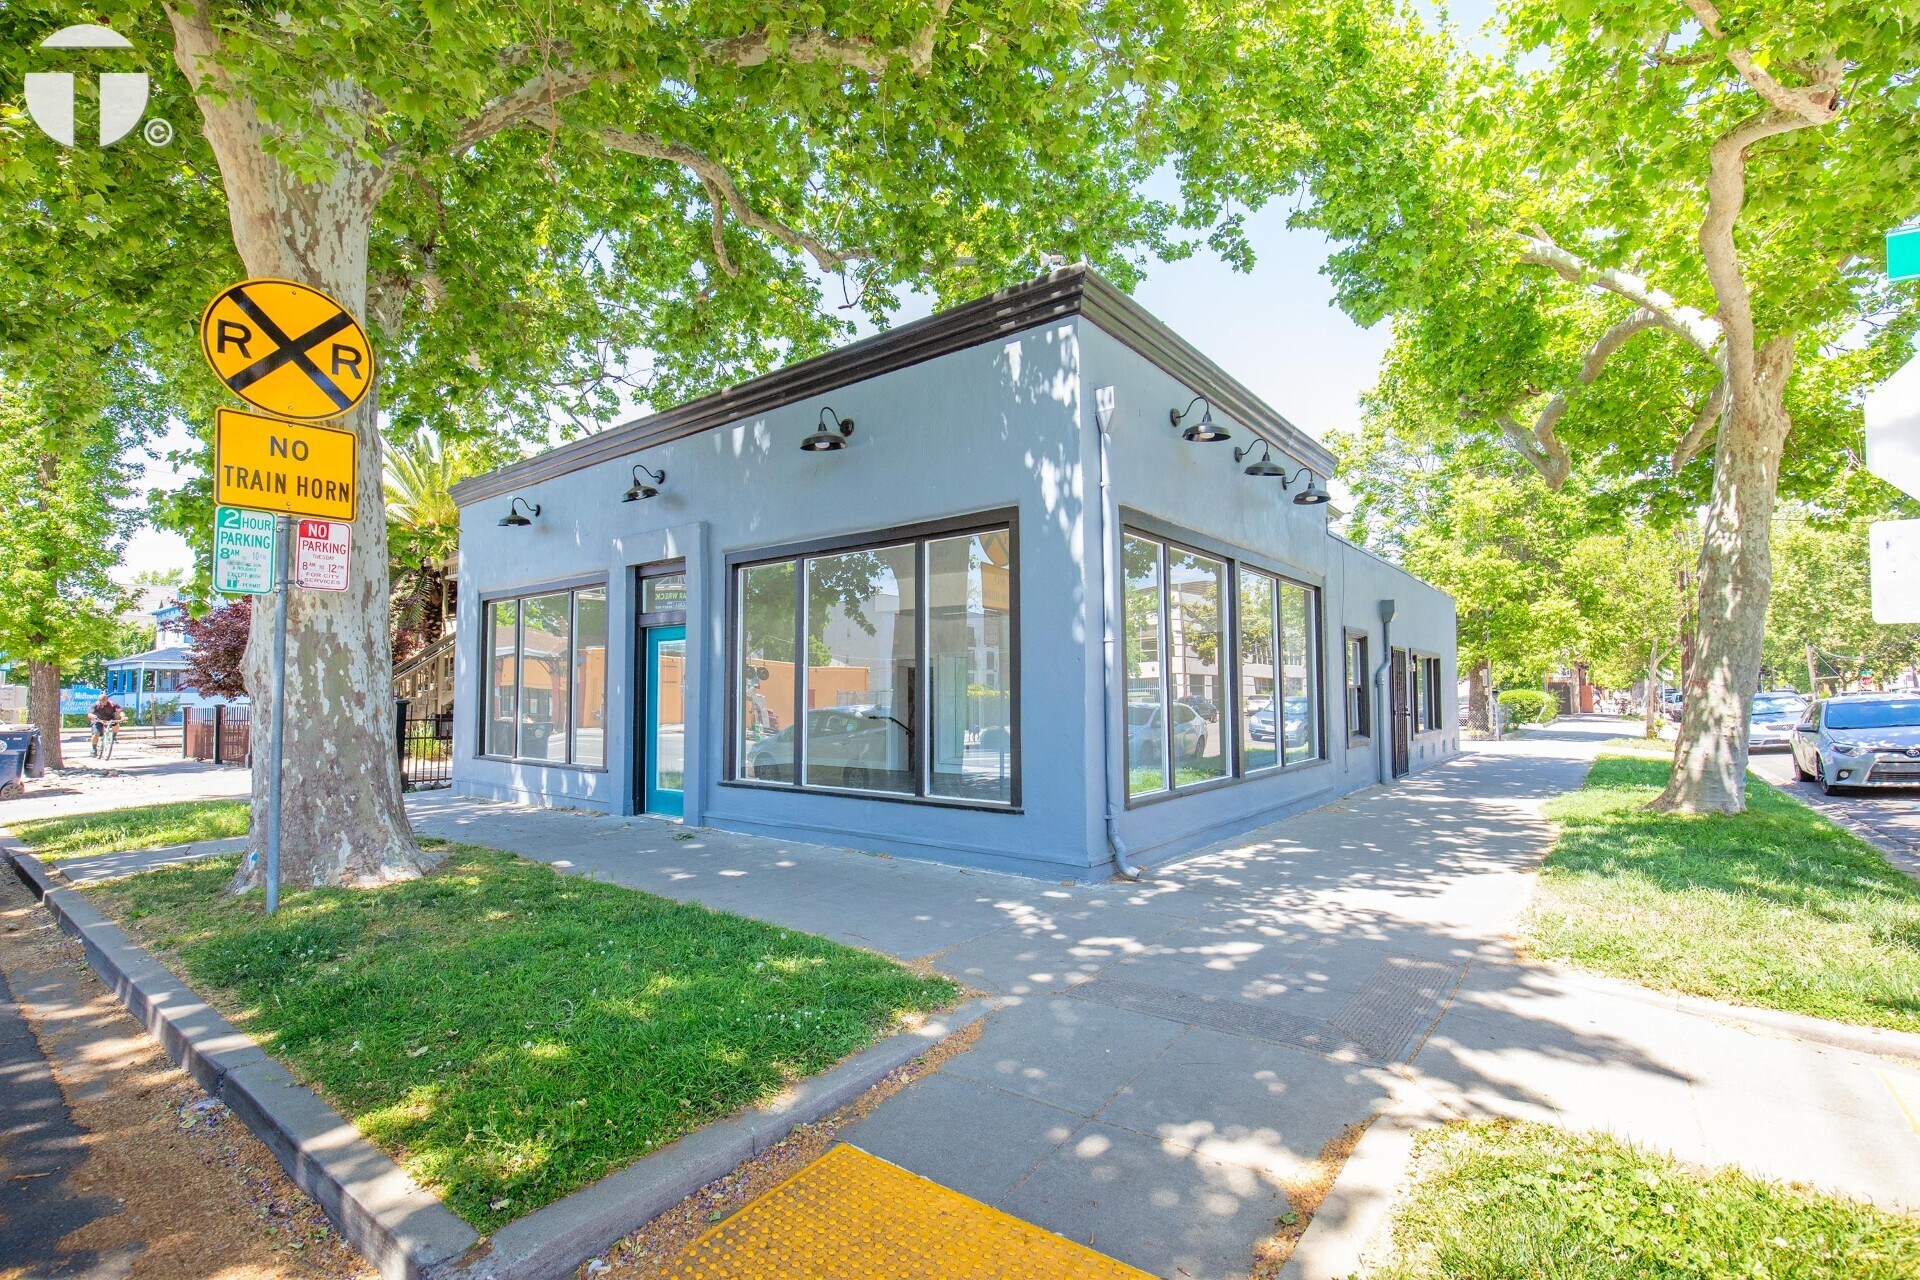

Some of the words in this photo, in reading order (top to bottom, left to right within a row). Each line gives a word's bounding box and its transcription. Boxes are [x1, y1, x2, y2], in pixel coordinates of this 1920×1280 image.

[217, 319, 252, 359] R
[331, 343, 363, 380] R
[270, 436, 309, 462] NO
[224, 465, 287, 494] TRAIN
[296, 475, 350, 503] HORN
[224, 509, 239, 528] 2
[242, 517, 271, 531] HOUR
[221, 531, 270, 549] PARKING
[308, 523, 327, 538] NO
[303, 540, 346, 555] PARKING
[304, 577, 341, 585] SERVICES
